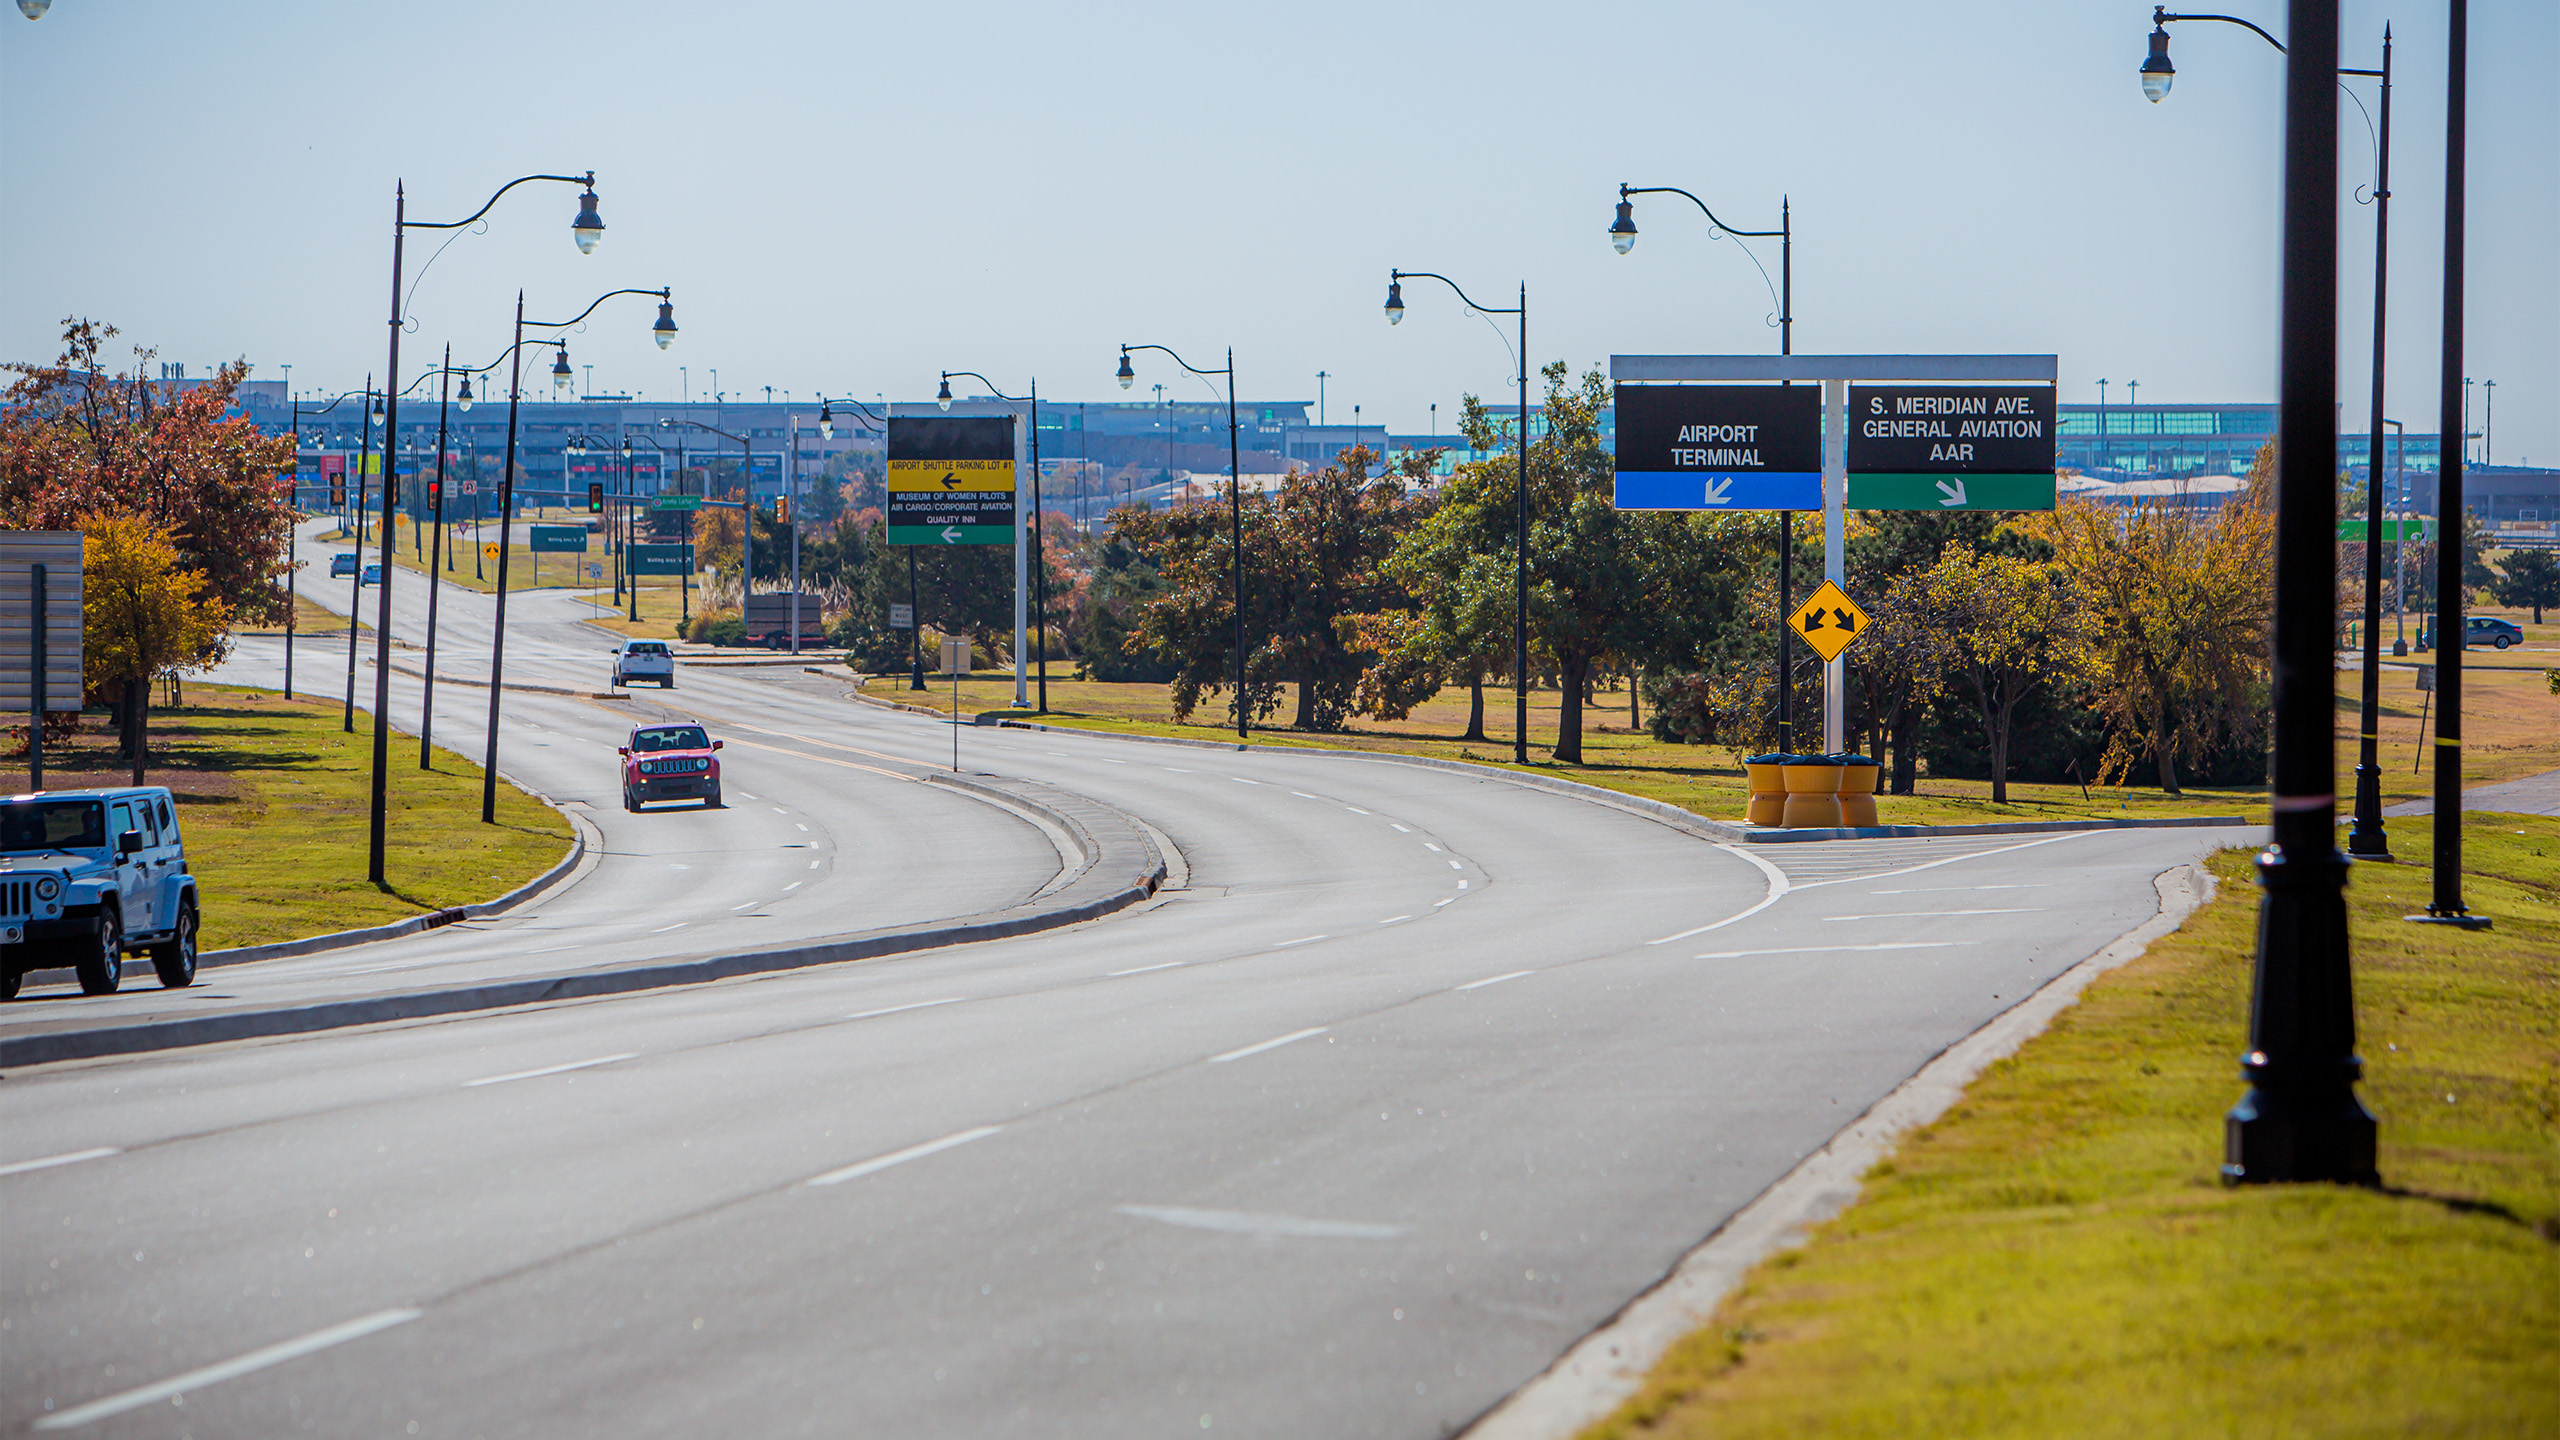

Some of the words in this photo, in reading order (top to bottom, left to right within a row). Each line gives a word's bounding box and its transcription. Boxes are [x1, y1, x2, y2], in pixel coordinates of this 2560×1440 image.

[1870, 397, 1888, 415] S.
[1896, 397, 1986, 415] MERIDIAN
[1994, 397, 2035, 415] AVE.
[1677, 425, 1758, 443] AIRPORT
[1863, 420, 1952, 438] GENERAL
[1959, 420, 2042, 438] AVIATION
[1671, 449, 1764, 466] TERMINAL
[1929, 443, 1974, 461] AAR
[891, 461, 920, 470] AIRPORT
[923, 461, 953, 470] SHUTTLE
[956, 461, 985, 470] PARKING
[987, 461, 1000, 470] LOT
[1003, 461, 1012, 470] #1
[979, 492, 1006, 500] PILOTS
[891, 503, 902, 511] AIR
[905, 503, 978, 511] CARGO/CORPORATE
[981, 502, 1012, 511] AVIATION
[926, 516, 959, 524] QUALITY
